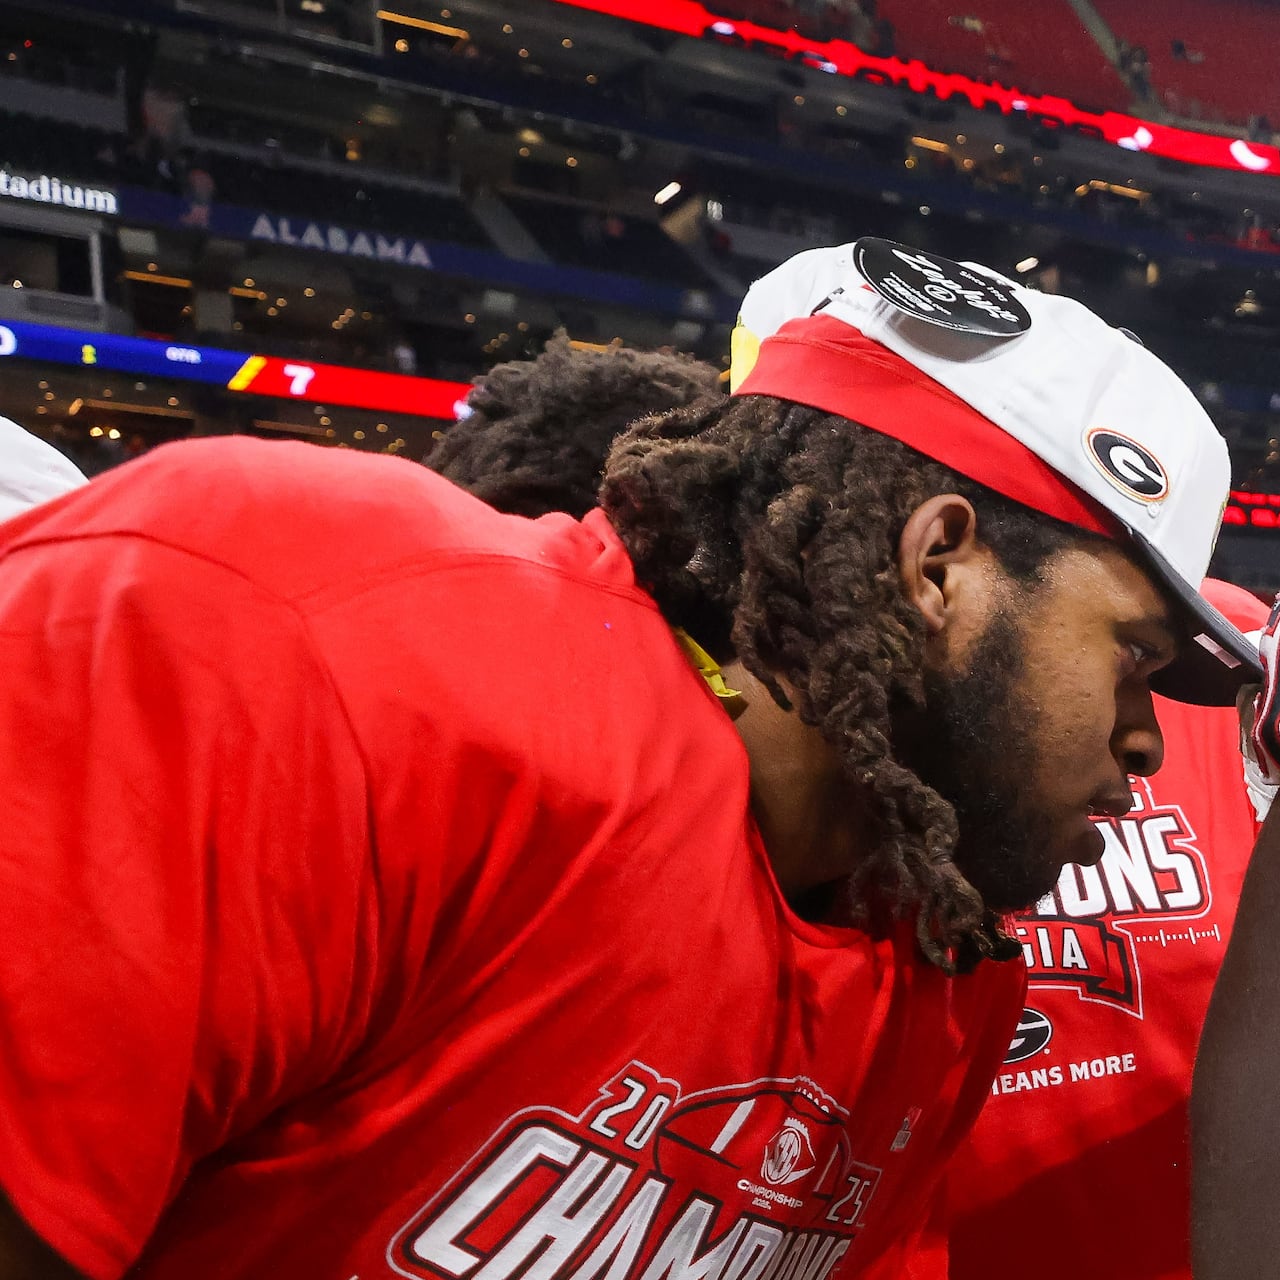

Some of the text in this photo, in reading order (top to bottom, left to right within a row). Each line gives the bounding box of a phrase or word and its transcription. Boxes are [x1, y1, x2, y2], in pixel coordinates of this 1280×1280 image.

[0, 169, 118, 214] tadium
[250, 213, 434, 270] ALABAMA
[284, 363, 315, 396] 7
[1069, 1052, 1137, 1083] MORE
[589, 1078, 870, 1225] 20 25
